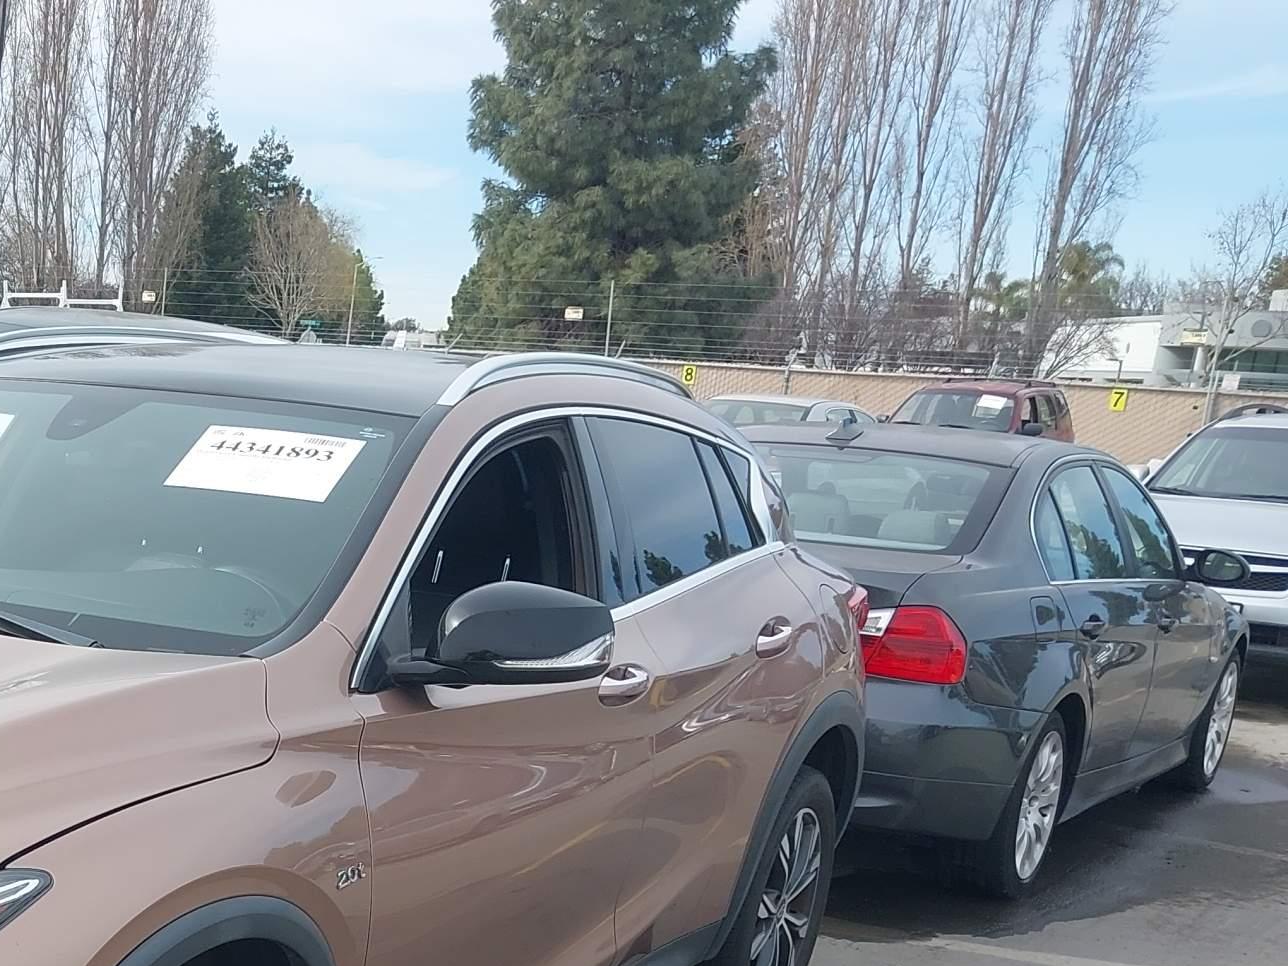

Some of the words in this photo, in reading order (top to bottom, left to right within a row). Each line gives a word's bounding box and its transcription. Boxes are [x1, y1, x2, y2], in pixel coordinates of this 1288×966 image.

[684, 367, 694, 381] 8
[1113, 391, 1125, 407] 7
[210, 440, 334, 462] 44341893
